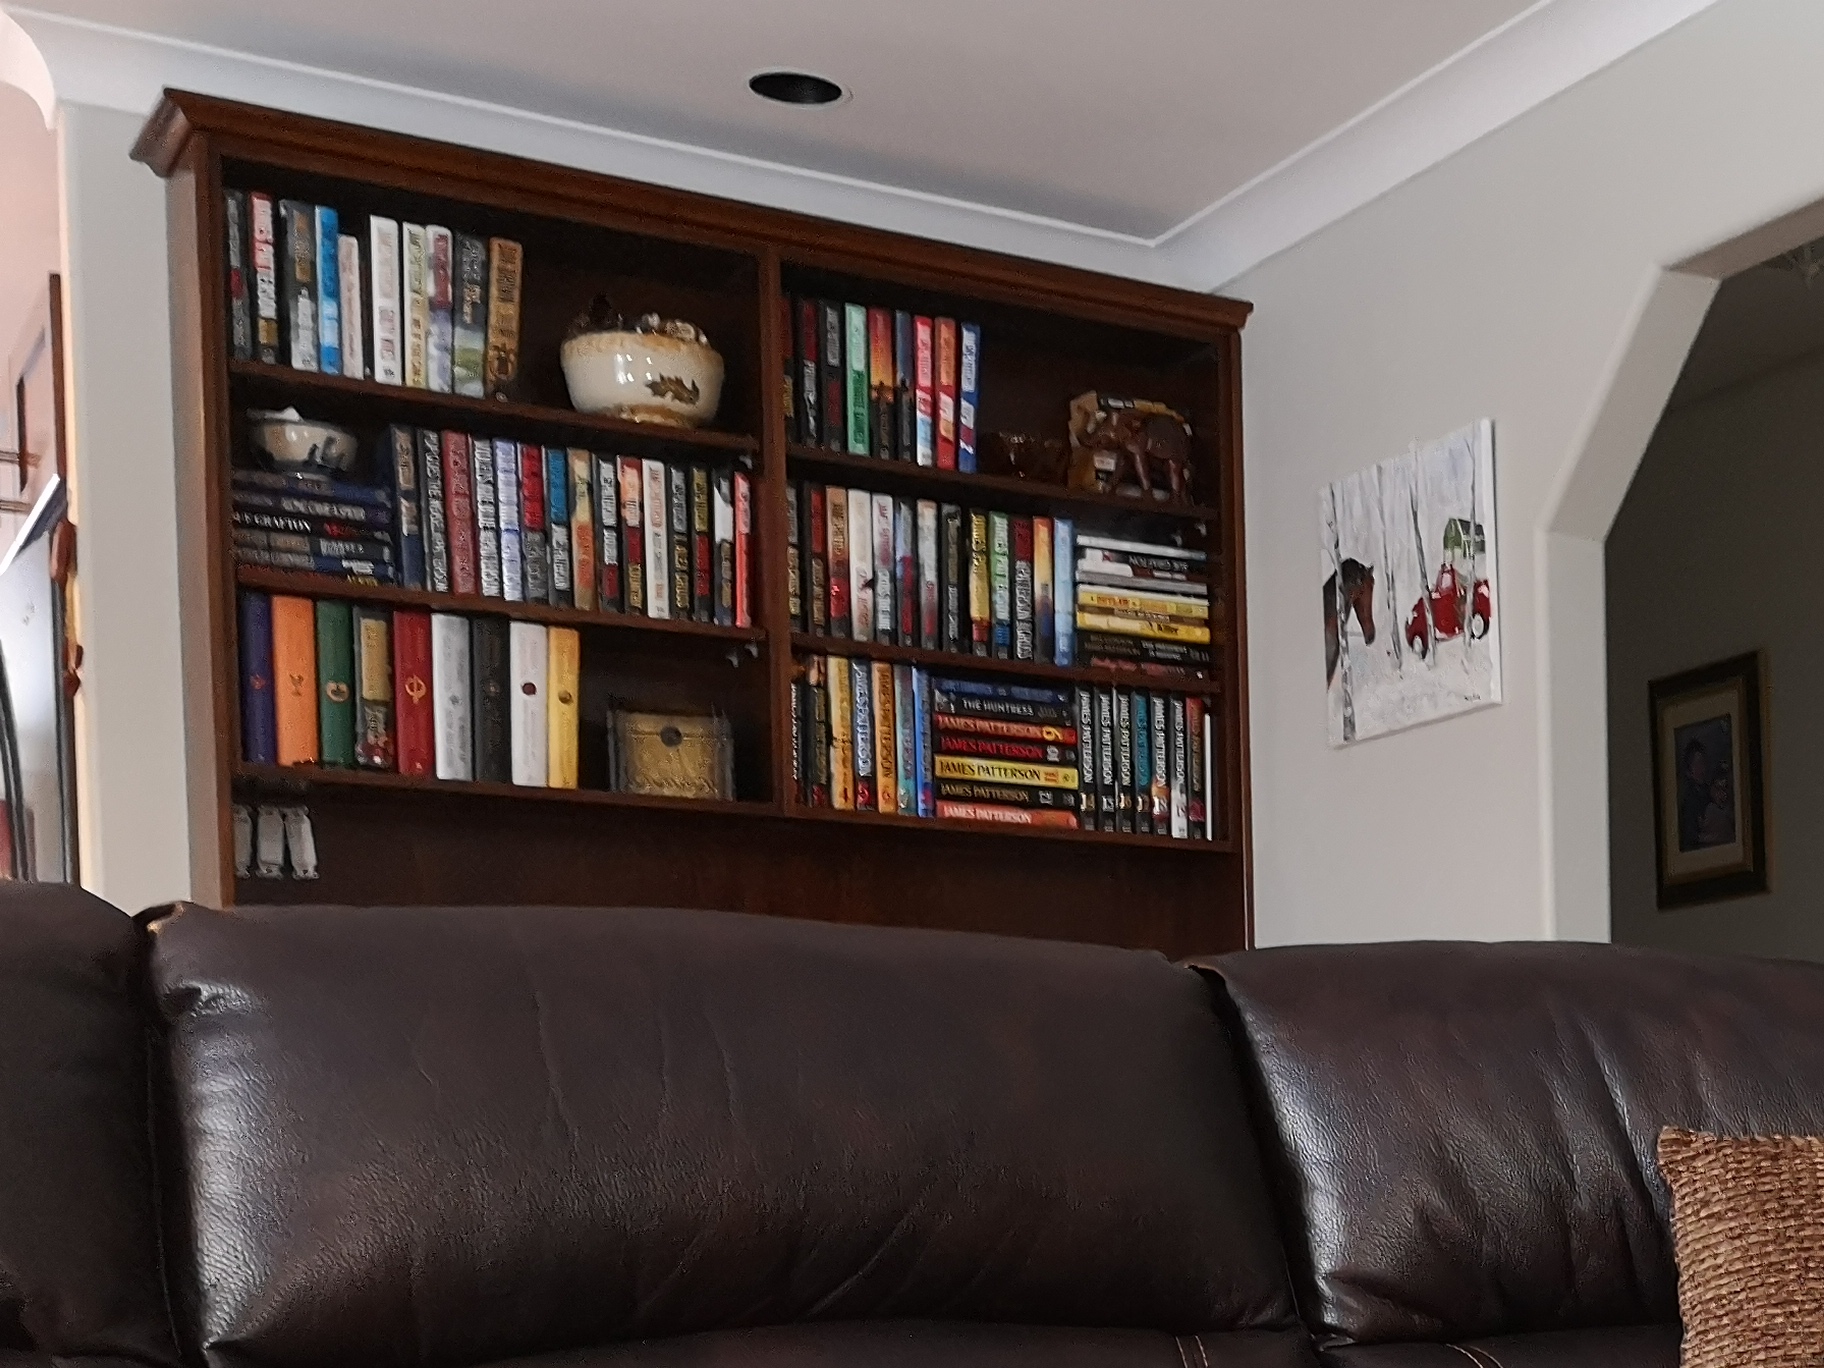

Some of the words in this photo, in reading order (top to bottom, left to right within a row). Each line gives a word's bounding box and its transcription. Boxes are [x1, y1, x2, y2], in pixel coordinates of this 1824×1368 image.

[961, 697, 982, 712] THE
[982, 699, 1034, 716] HUNTRESS
[1079, 691, 1091, 724] JAMES
[1099, 693, 1111, 726] JAMES
[1118, 693, 1130, 729] JAMES
[1152, 696, 1165, 730] JAMES
[937, 714, 975, 731] JAMES
[975, 717, 1043, 739] PATTERSON
[940, 736, 977, 753] JAMES
[978, 740, 1043, 759] PATTERSON
[1081, 725, 1093, 784] PATTERSON
[1101, 727, 1114, 786] PATTERSON
[1120, 729, 1132, 787] PATTERSON
[1154, 730, 1167, 787] PATTERSON
[939, 760, 976, 777] JAMES
[977, 764, 1041, 782] PATTERSON
[940, 782, 973, 798] JAMES
[973, 785, 1030, 803] PATTERSON
[943, 804, 975, 818] JAMES
[975, 808, 1033, 824] PATTERSON
